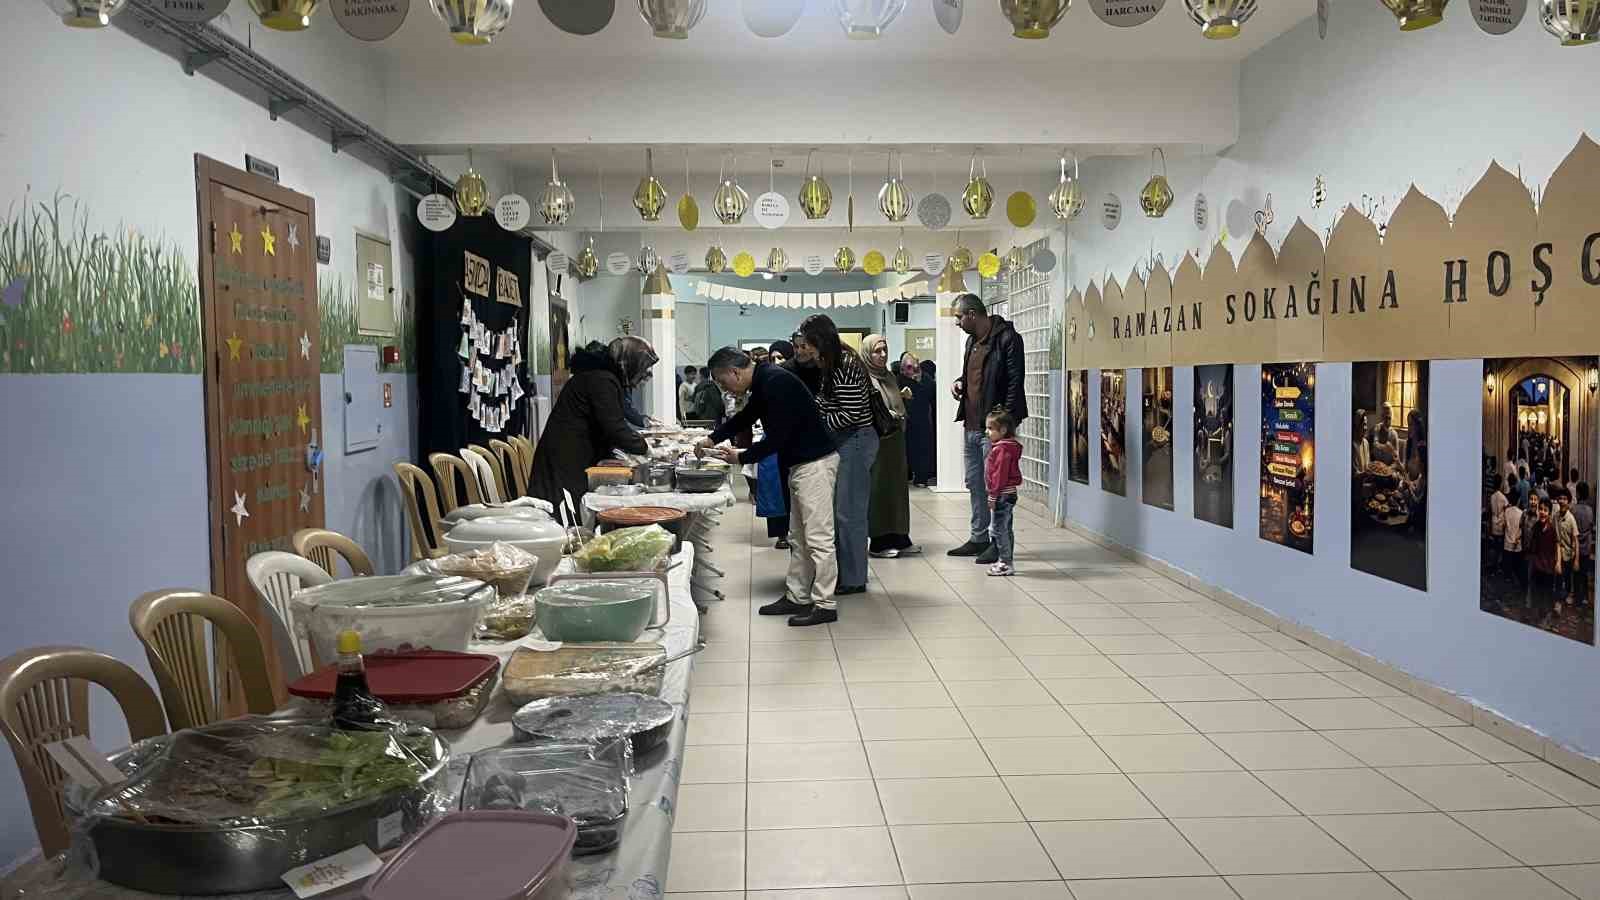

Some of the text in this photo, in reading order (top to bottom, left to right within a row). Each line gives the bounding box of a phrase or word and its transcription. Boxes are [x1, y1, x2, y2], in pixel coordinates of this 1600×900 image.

[1105, 5, 1156, 16] HARCAMA
[1112, 302, 1203, 339] RAMAZAN
[1226, 270, 1400, 325] SOKAĞINA
